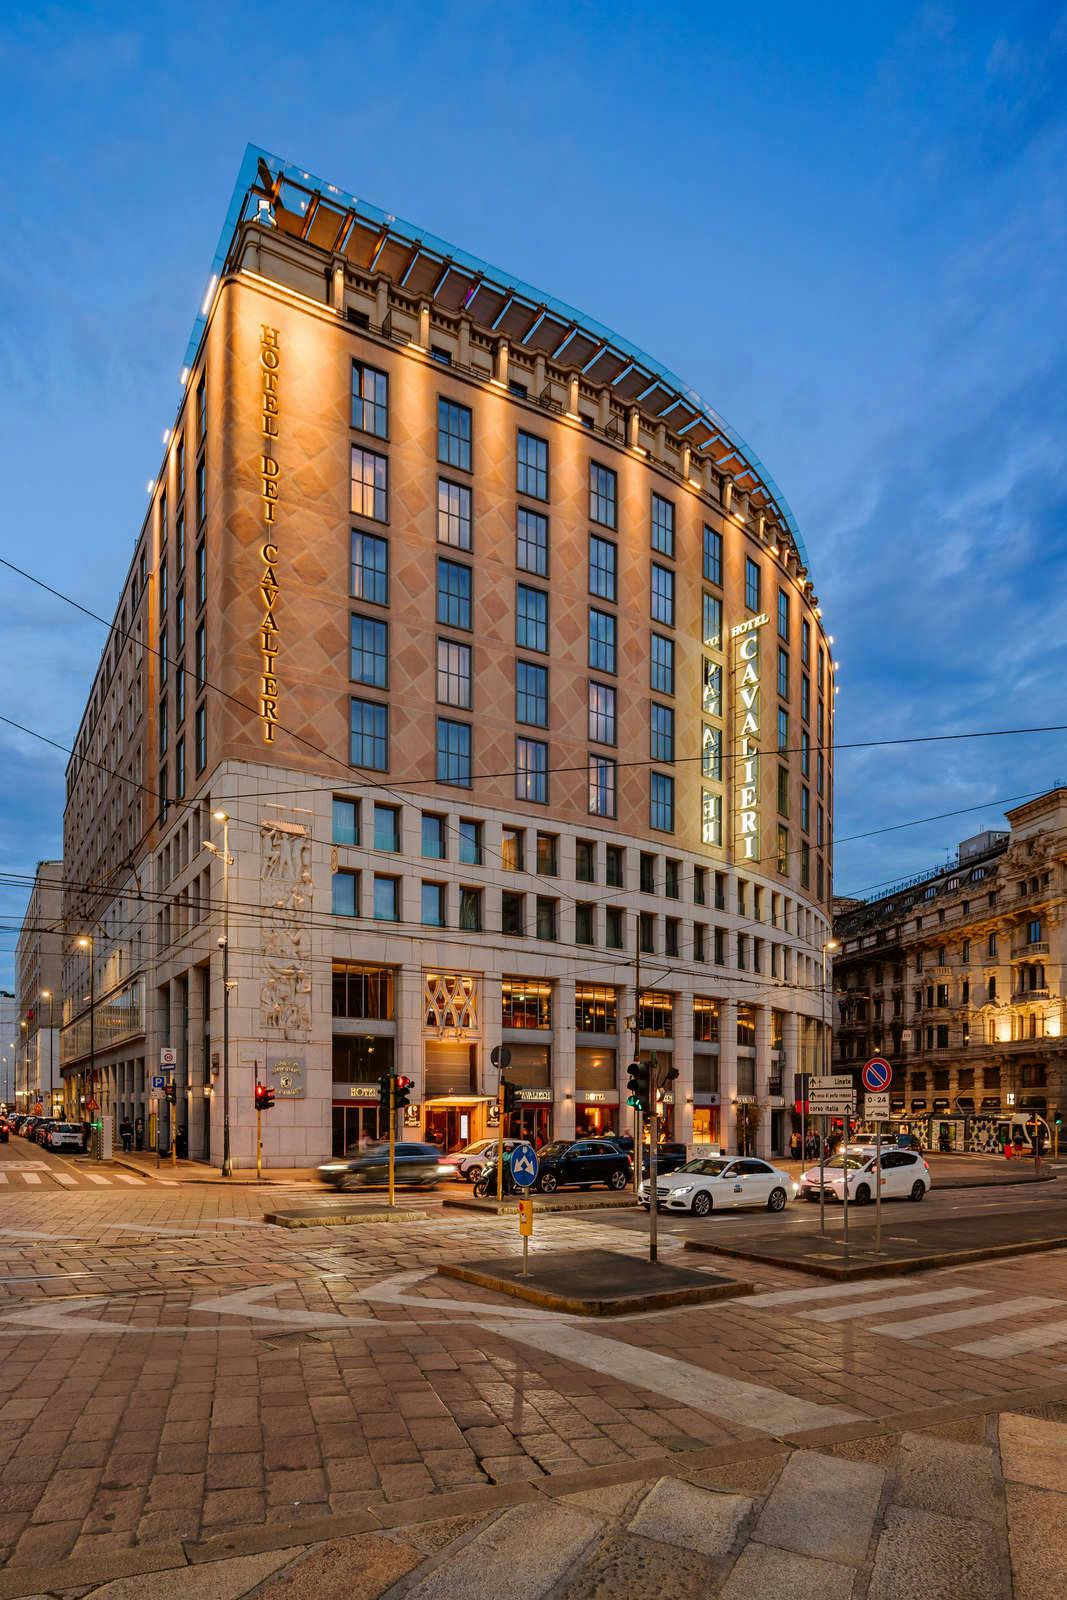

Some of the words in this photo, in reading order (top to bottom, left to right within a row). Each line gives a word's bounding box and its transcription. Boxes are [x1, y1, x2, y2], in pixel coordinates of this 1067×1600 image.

[260, 324, 280, 438] HOTEL
[261, 455, 279, 522] DEI
[260, 544, 280, 742] CAVALIERI
[731, 613, 769, 638] HOTEL
[740, 635, 760, 858] CAVALIERI
